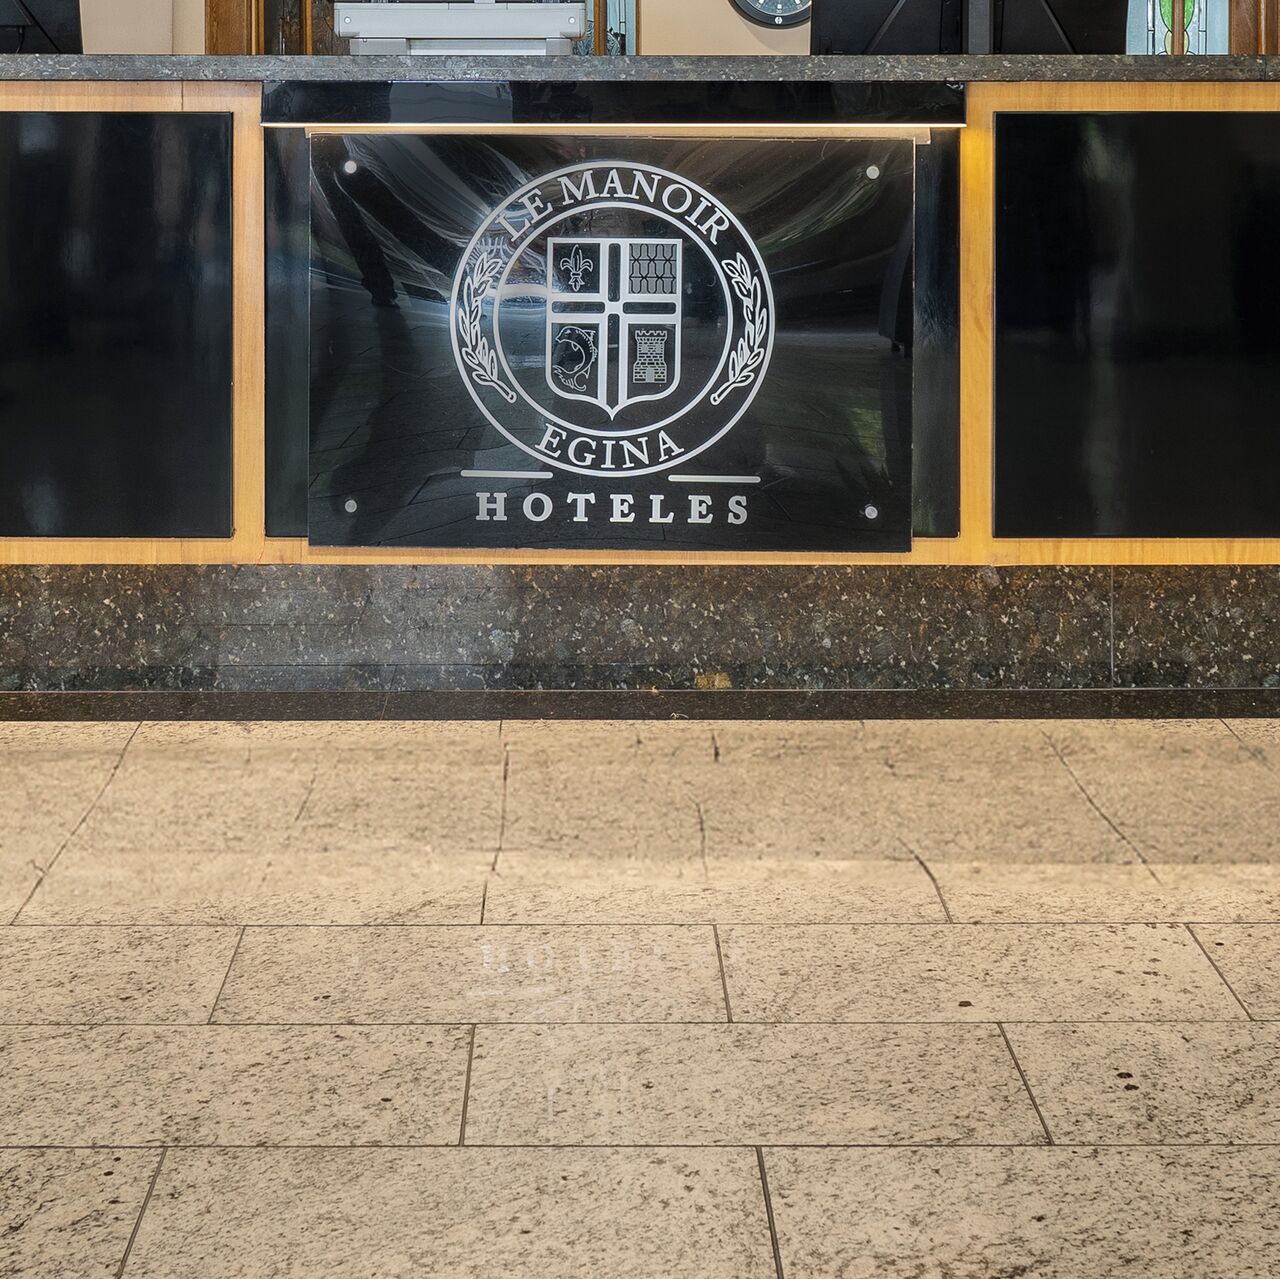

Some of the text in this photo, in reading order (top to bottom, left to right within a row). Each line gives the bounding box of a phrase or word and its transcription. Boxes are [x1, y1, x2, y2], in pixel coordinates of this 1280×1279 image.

[495, 168, 730, 245] LE MANOIR
[534, 423, 685, 469] EGINA
[475, 492, 748, 524] HOTELES
